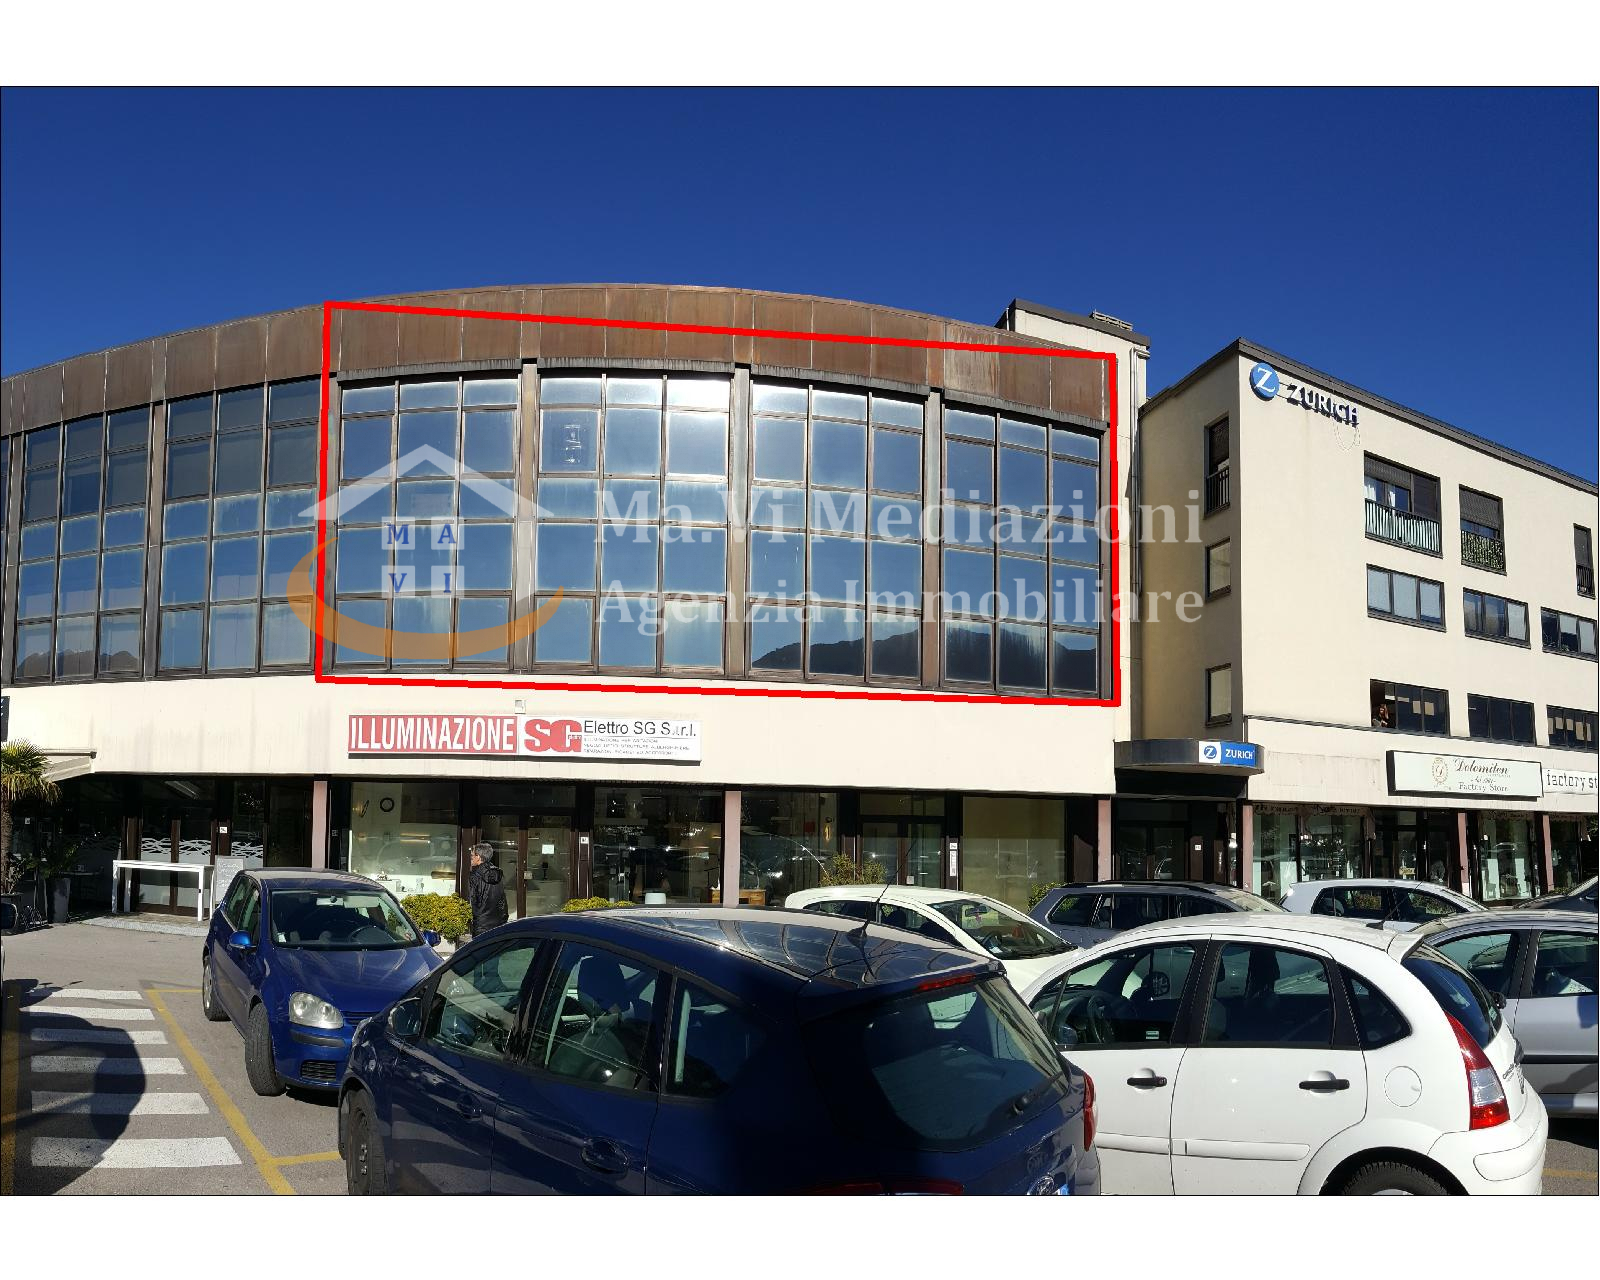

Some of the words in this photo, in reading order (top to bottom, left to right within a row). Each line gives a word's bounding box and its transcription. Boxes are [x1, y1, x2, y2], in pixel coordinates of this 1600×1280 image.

[1287, 383, 1359, 428] ZURICH
[351, 717, 515, 750] ILLUMINAZIONE
[524, 719, 582, 752] SG
[584, 720, 629, 735] Elettro
[634, 721, 656, 736] SG
[1225, 749, 1253, 760] ZURICH
[1454, 758, 1509, 775] Dolomiten
[1547, 770, 1586, 791] factory
